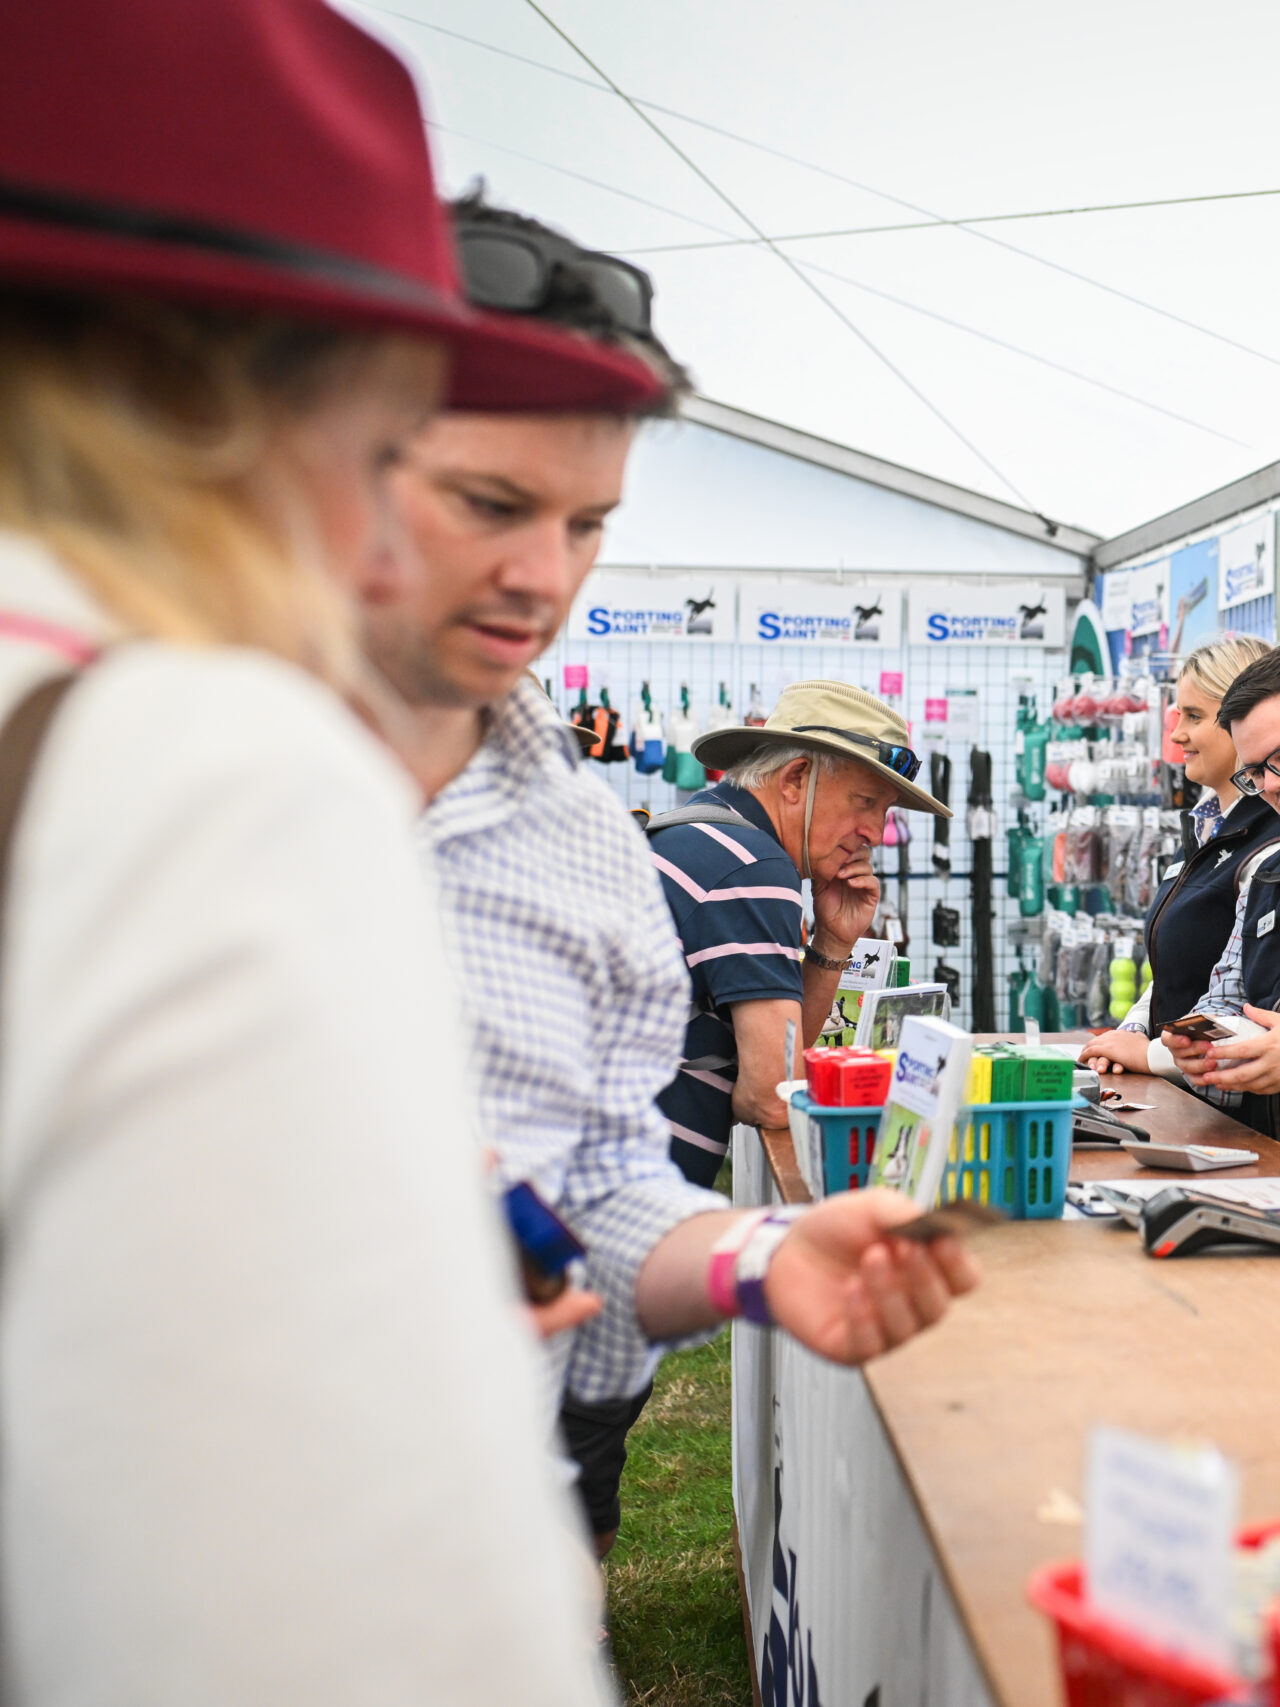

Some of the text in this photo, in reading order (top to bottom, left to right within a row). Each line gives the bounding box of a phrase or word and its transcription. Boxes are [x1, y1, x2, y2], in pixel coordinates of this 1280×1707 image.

[588, 608, 682, 635] SPORTING
[758, 613, 850, 640] SPORTING
[927, 614, 1016, 641] SPORTING
